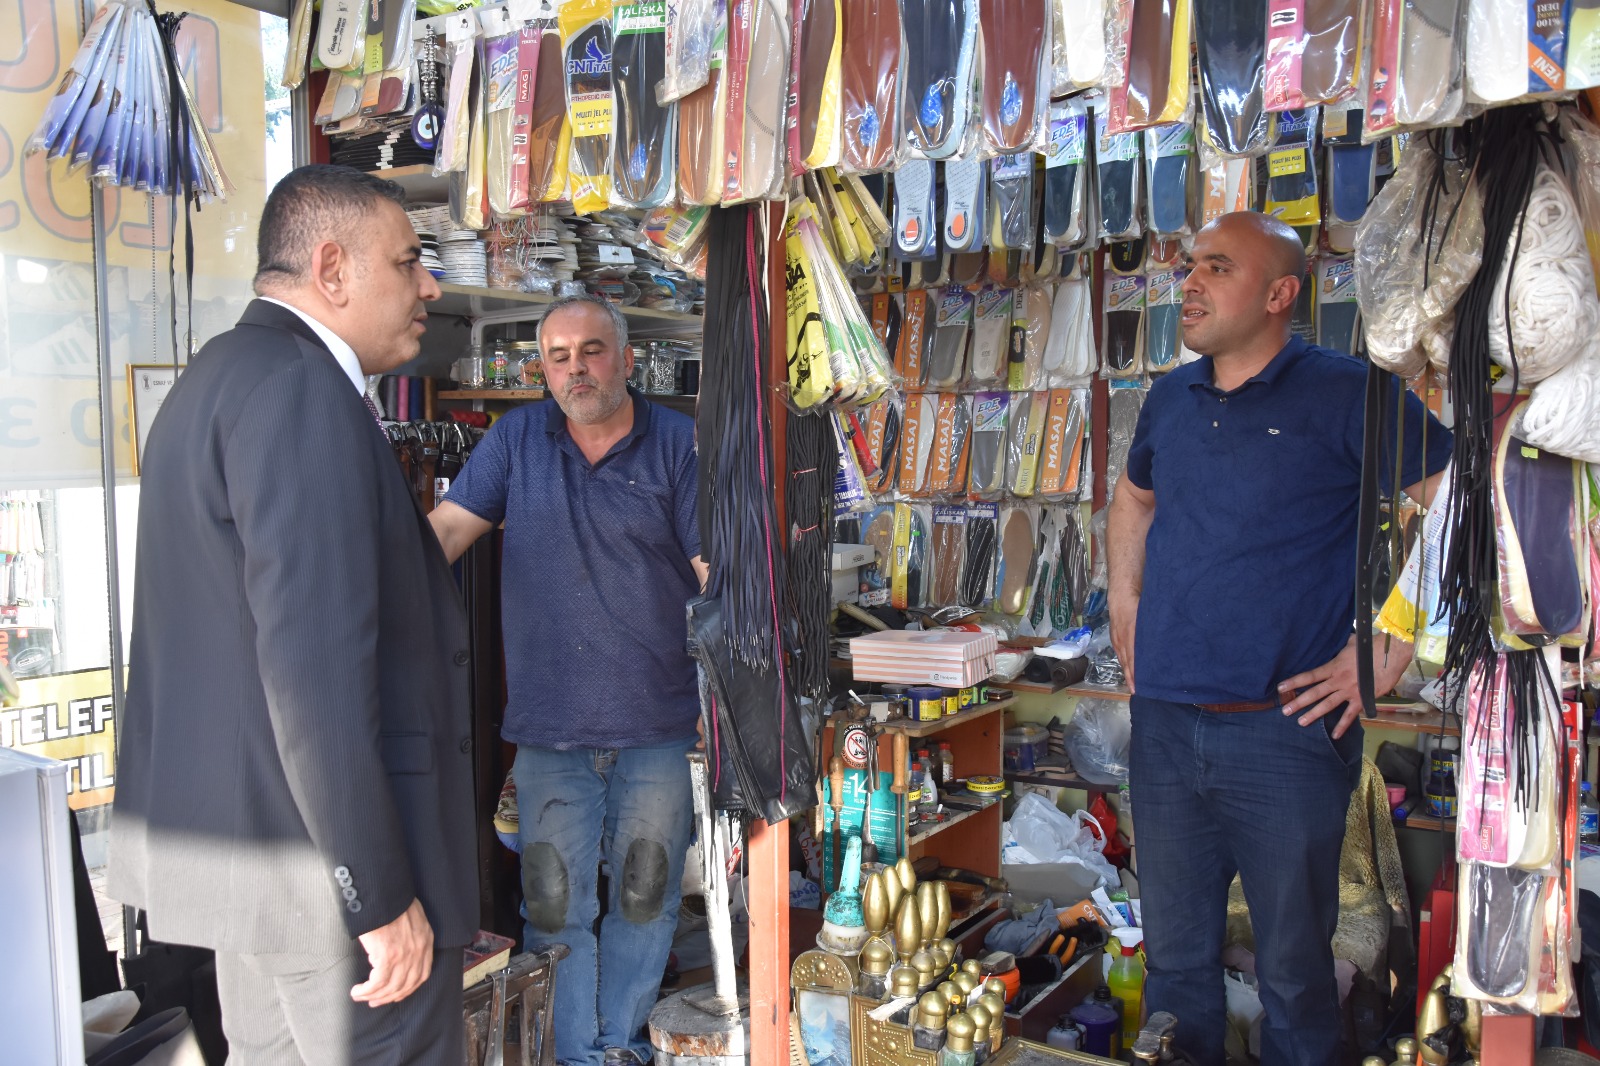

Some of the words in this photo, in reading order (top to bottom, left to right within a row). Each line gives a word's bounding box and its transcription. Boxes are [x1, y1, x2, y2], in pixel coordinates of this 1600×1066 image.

[1531, 55, 1562, 84] YENİ
[521, 73, 529, 100] MAG
[1110, 277, 1136, 292] EDE
[1150, 271, 1174, 288] EDE
[941, 294, 962, 308] EDE
[978, 290, 999, 304] EDE
[978, 398, 1000, 413] EDE
[870, 420, 883, 466] ASAJ
[905, 418, 918, 471] MASAJ
[937, 418, 951, 472] MASAJ
[1047, 415, 1064, 469] MASAJ
[1482, 828, 1490, 850] GÜLER
